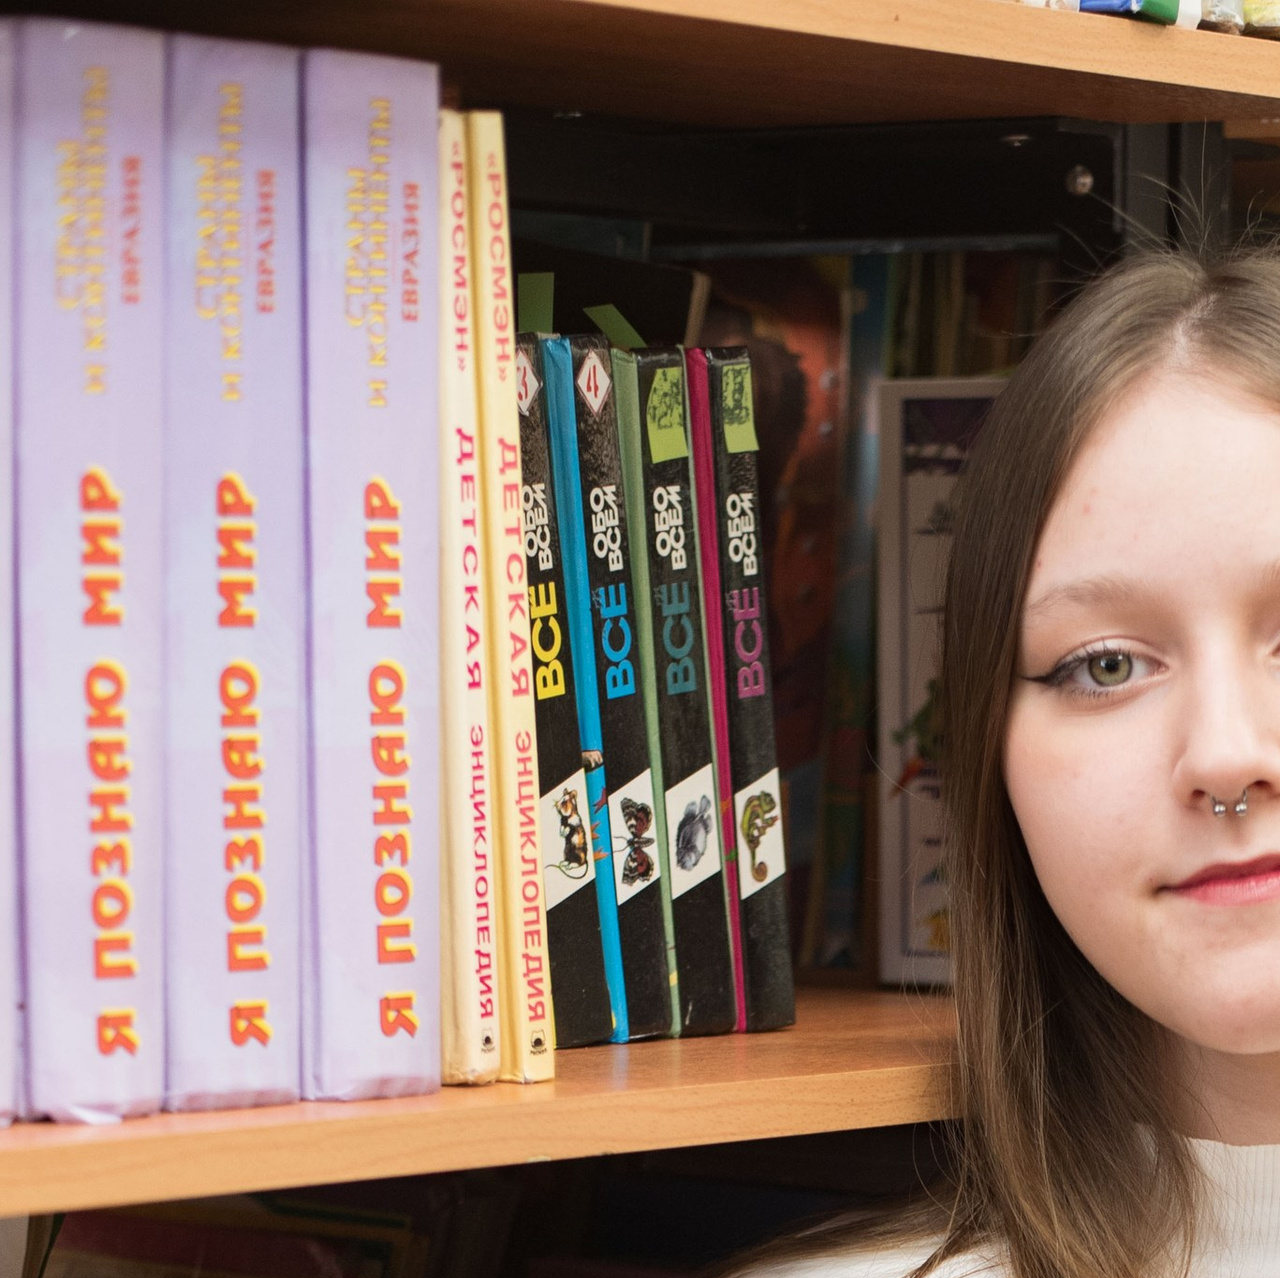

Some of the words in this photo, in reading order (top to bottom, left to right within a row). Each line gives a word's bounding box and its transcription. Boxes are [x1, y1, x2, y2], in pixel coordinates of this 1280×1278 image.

[257, 169, 276, 314] ЕВРАЗИЯ
[401, 182, 420, 323] ЕВРАЗИЯ
[586, 364, 599, 398] 4
[79, 464, 125, 629] МИР
[215, 470, 260, 629] МИР
[363, 476, 403, 630] МИР
[531, 482, 554, 571] ВСЕМ
[590, 487, 609, 559] ОБО
[602, 485, 624, 572] ВСЕМ
[653, 486, 672, 558] ОБО
[664, 484, 687, 571] ВСЕМ
[726, 493, 744, 563] ОБО
[739, 492, 758, 576] ВСЕМ
[456, 427, 482, 692] ДЕТСКАЯ
[469, 724, 495, 1020] ЭНЦИКЛОПЕДИЯ
[497, 437, 530, 698] ДЕТСКАЯ
[515, 730, 547, 1023] ЭНЦИКЛОПЕДИЯ
[84, 658, 139, 981] ПОЗНАЮ
[217, 658, 271, 974] ПОЗНАЮ
[367, 659, 418, 966] ПОЗНАЮ
[95, 1007, 141, 1057] Я
[228, 999, 272, 1048] Я
[378, 991, 420, 1040] Я
